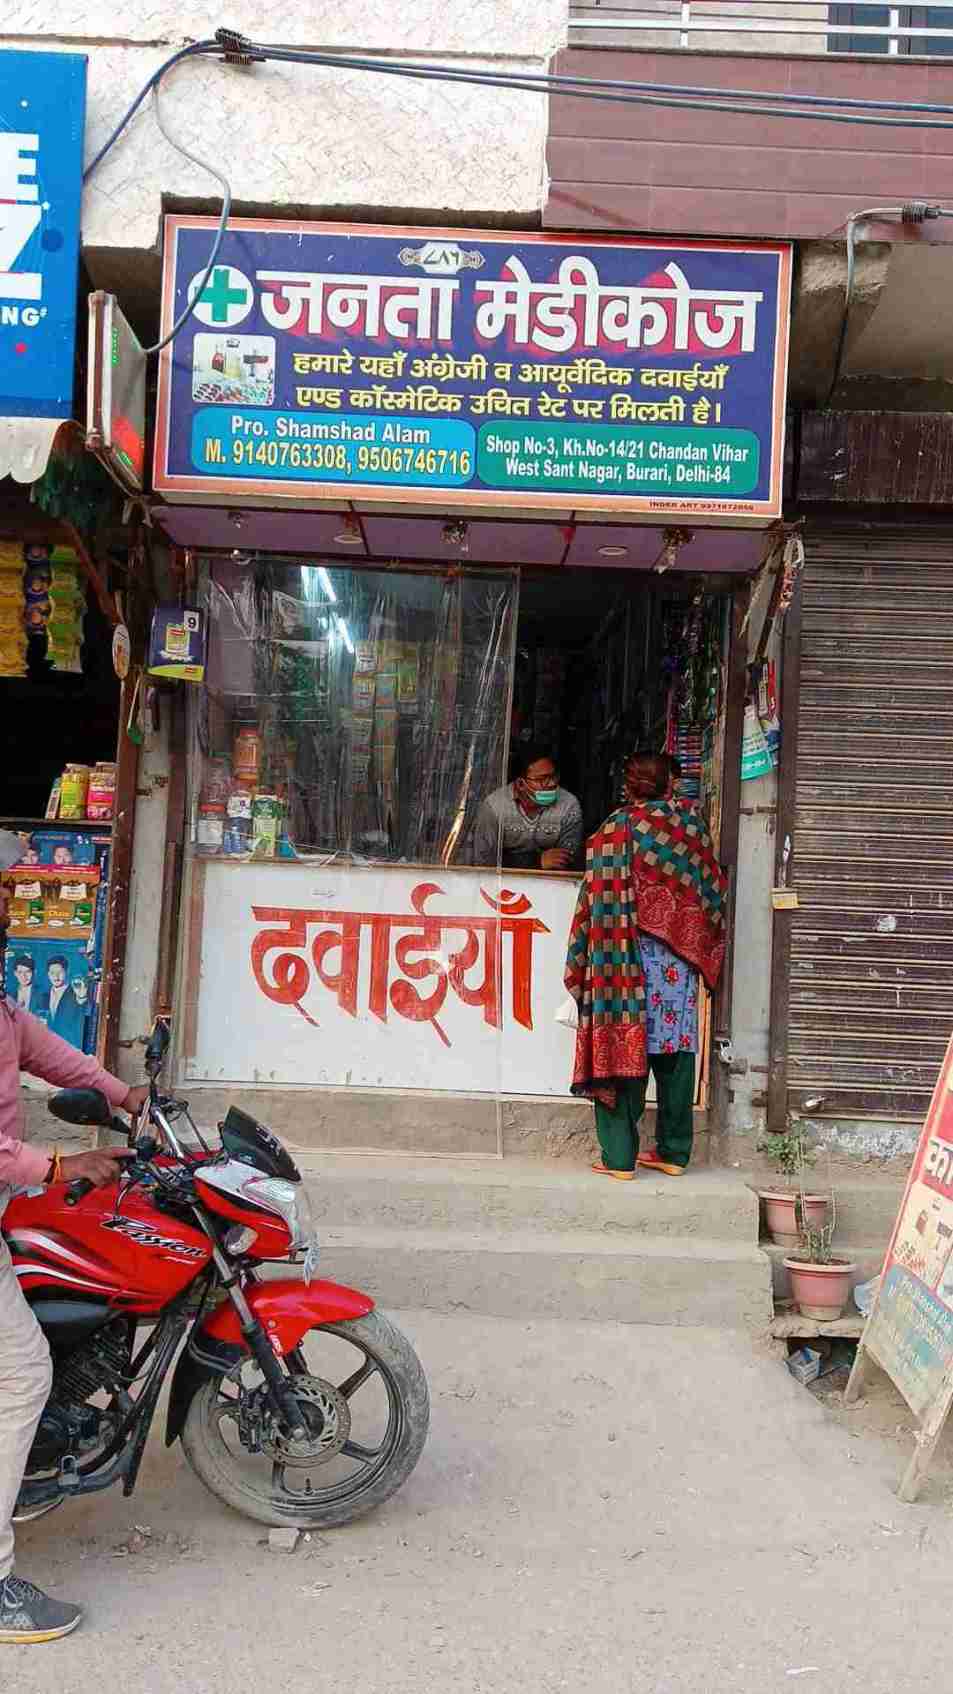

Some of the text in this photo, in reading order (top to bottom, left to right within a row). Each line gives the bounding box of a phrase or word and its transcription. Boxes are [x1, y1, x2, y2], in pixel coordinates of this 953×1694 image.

[256, 255, 764, 352] जनता मेडीकोज
[292, 349, 355, 375] हमारे
[359, 352, 408, 377] यहाँ
[410, 353, 488, 382] अंग्रेजी
[494, 362, 512, 381] व
[640, 362, 729, 392] दवाईयाँ
[295, 386, 344, 408] एण्ड
[349, 385, 464, 414] कॉस्मेटिक
[469, 387, 531, 416] उचित
[537, 391, 569, 417] रेट
[572, 398, 606, 420] पर
[611, 393, 688, 422] मिलती
[231, 415, 430, 444] Pro. Shamshad Alam
[205, 438, 471, 475] M. 9140763308, 9506746716
[486, 435, 749, 462] Shop No-3, Kh.No-14/21 Chandan Vihar
[506, 457, 731, 484] West Sant Nagar, Burari, Delhi-84
[250, 882, 552, 1048] दवाईयाँ
